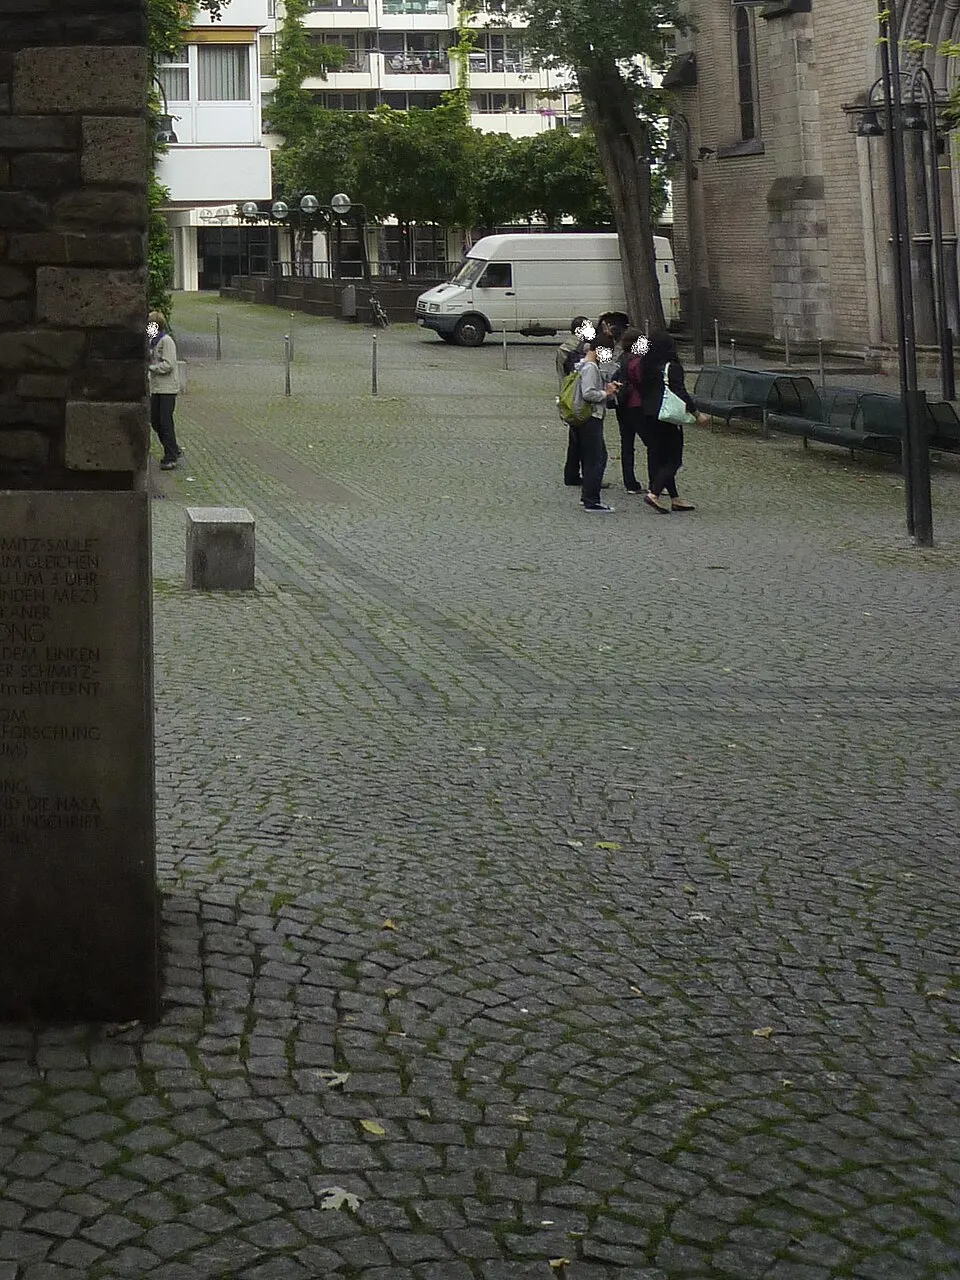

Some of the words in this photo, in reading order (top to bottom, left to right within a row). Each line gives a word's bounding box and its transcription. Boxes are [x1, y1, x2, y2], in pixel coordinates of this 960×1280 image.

[1, 555, 22, 569] IM
[26, 554, 100, 570] GLEICHEN
[14, 571, 44, 586] UM
[64, 571, 100, 587] UHR
[2, 646, 39, 661] DEM
[45, 646, 100, 662] LINKEN
[19, 663, 101, 679] SCHMITZ-
[21, 680, 101, 696] ENTFERNT
[26, 796, 51, 812] DIE
[56, 796, 101, 812] NASA
